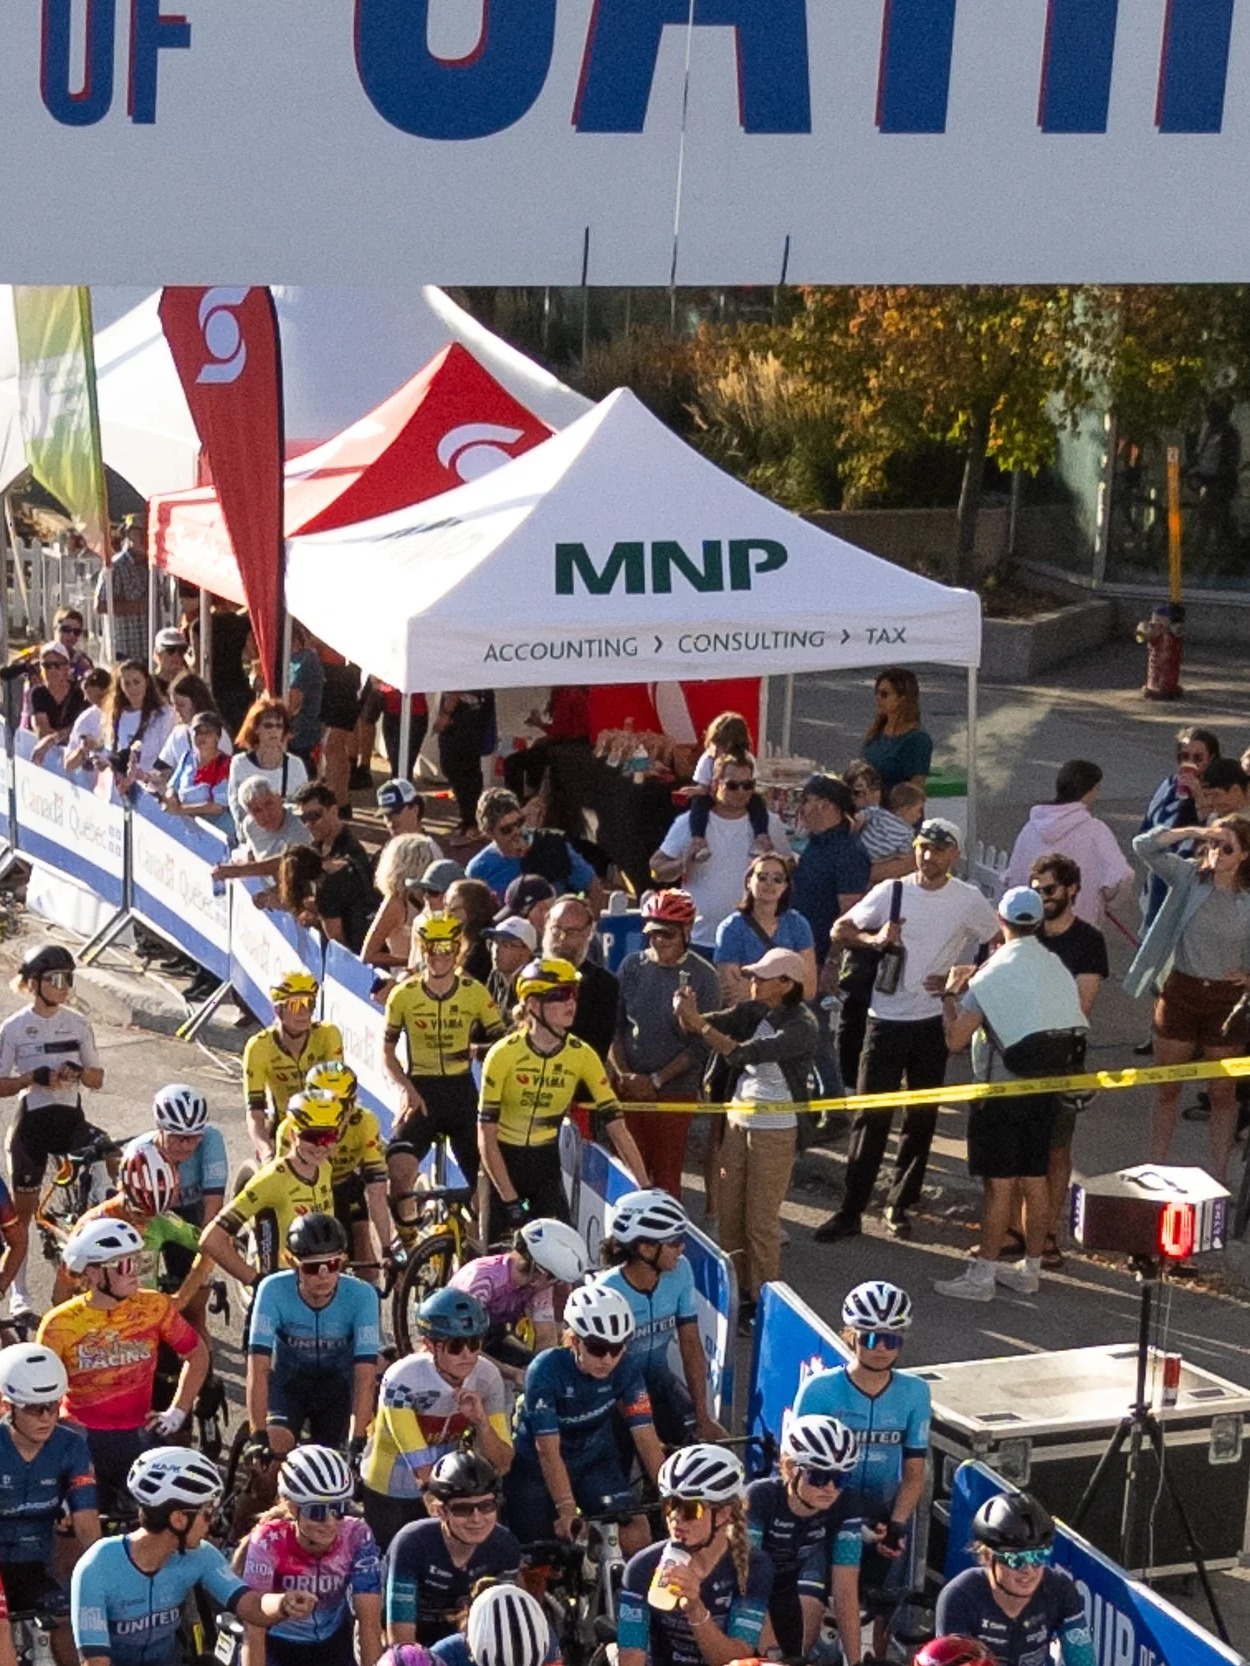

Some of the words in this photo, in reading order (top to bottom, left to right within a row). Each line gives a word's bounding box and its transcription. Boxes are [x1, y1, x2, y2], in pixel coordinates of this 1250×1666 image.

[555, 538, 788, 594] MNP
[484, 635, 639, 663] ACCOUNTING
[678, 630, 825, 655] CONSULTING
[866, 626, 908, 646] TAX
[634, 1316, 676, 1338] NITED
[79, 1350, 151, 1370] RACING
[282, 1573, 347, 1594] ORION
[116, 1607, 180, 1635] UNITED
